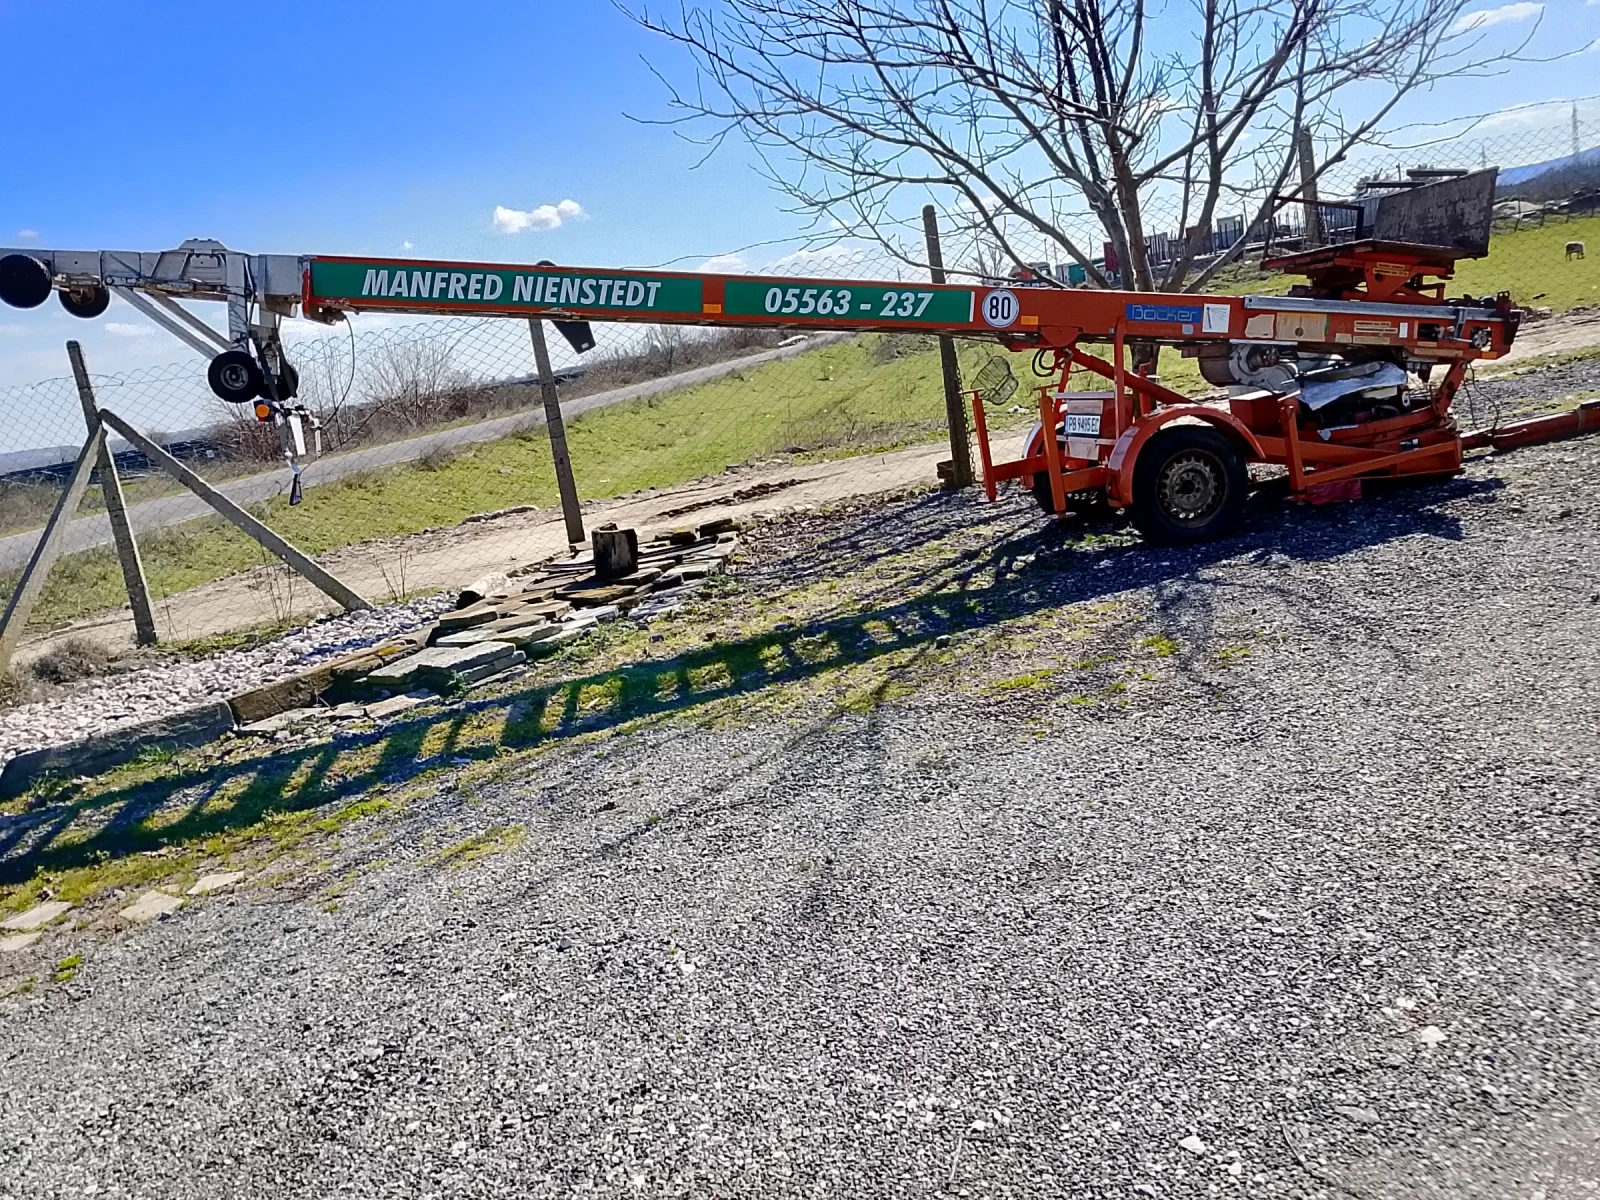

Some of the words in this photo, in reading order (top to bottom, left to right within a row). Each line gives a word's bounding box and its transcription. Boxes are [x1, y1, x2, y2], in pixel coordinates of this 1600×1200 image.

[362, 269, 503, 300] MANFRED
[512, 275, 661, 307] NIENSTEDT
[764, 287, 852, 316] 05563
[879, 291, 935, 318] 237
[988, 295, 1012, 320] 80
[1131, 304, 1198, 322] Böcker
